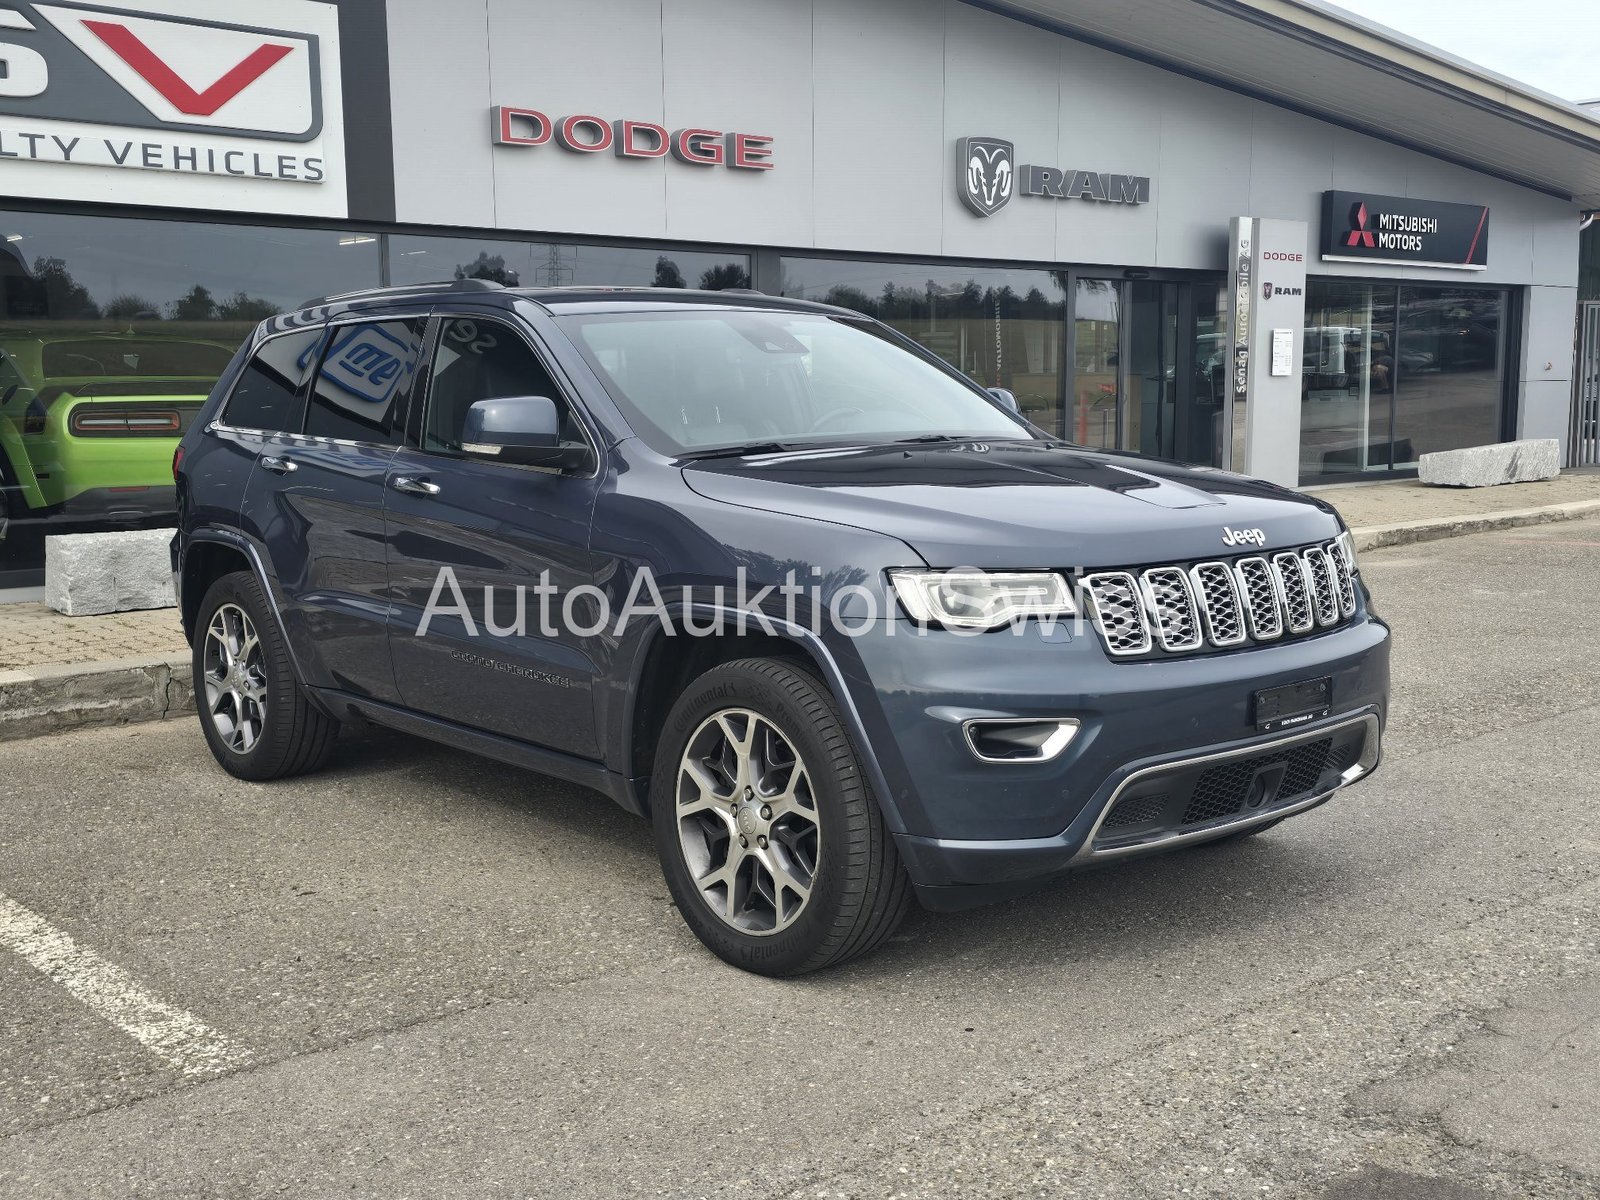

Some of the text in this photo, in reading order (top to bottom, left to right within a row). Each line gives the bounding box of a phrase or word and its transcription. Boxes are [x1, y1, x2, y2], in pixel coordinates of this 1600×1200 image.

[490, 105, 774, 171] DODGE
[103, 139, 323, 181] VEHICLES
[1020, 164, 1149, 204] RAM
[1379, 213, 1437, 233] MITSUBISHI
[1378, 232, 1422, 250] MOTORS
[1263, 252, 1303, 261] DODGE
[1274, 287, 1302, 296] RAM
[1222, 526, 1266, 547] Jeep
